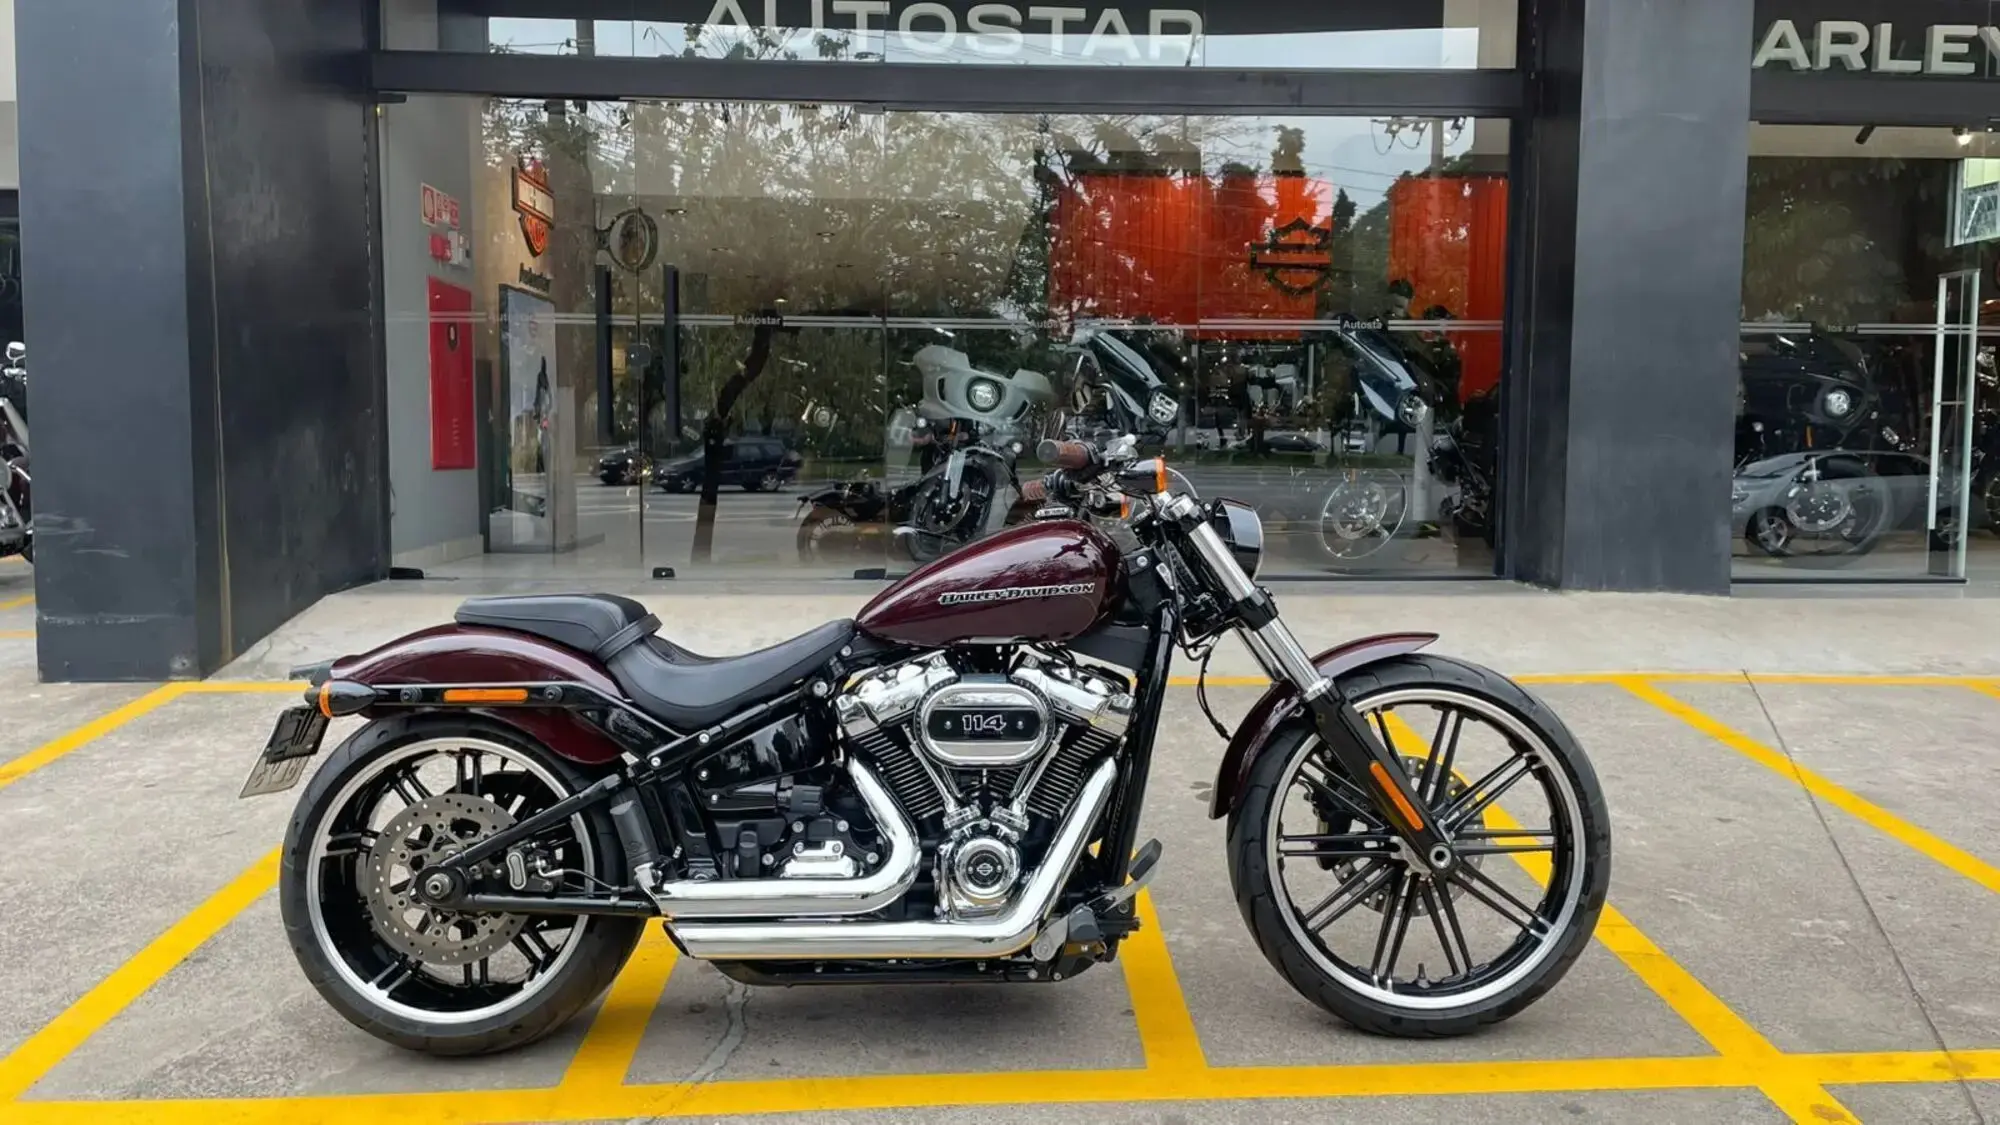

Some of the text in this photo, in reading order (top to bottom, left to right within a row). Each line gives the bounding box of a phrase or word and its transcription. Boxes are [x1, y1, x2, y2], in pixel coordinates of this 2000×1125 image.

[695, 0, 1203, 61] AUTOSTAR
[736, 314, 781, 325] Autostar
[962, 714, 1007, 731] 114
